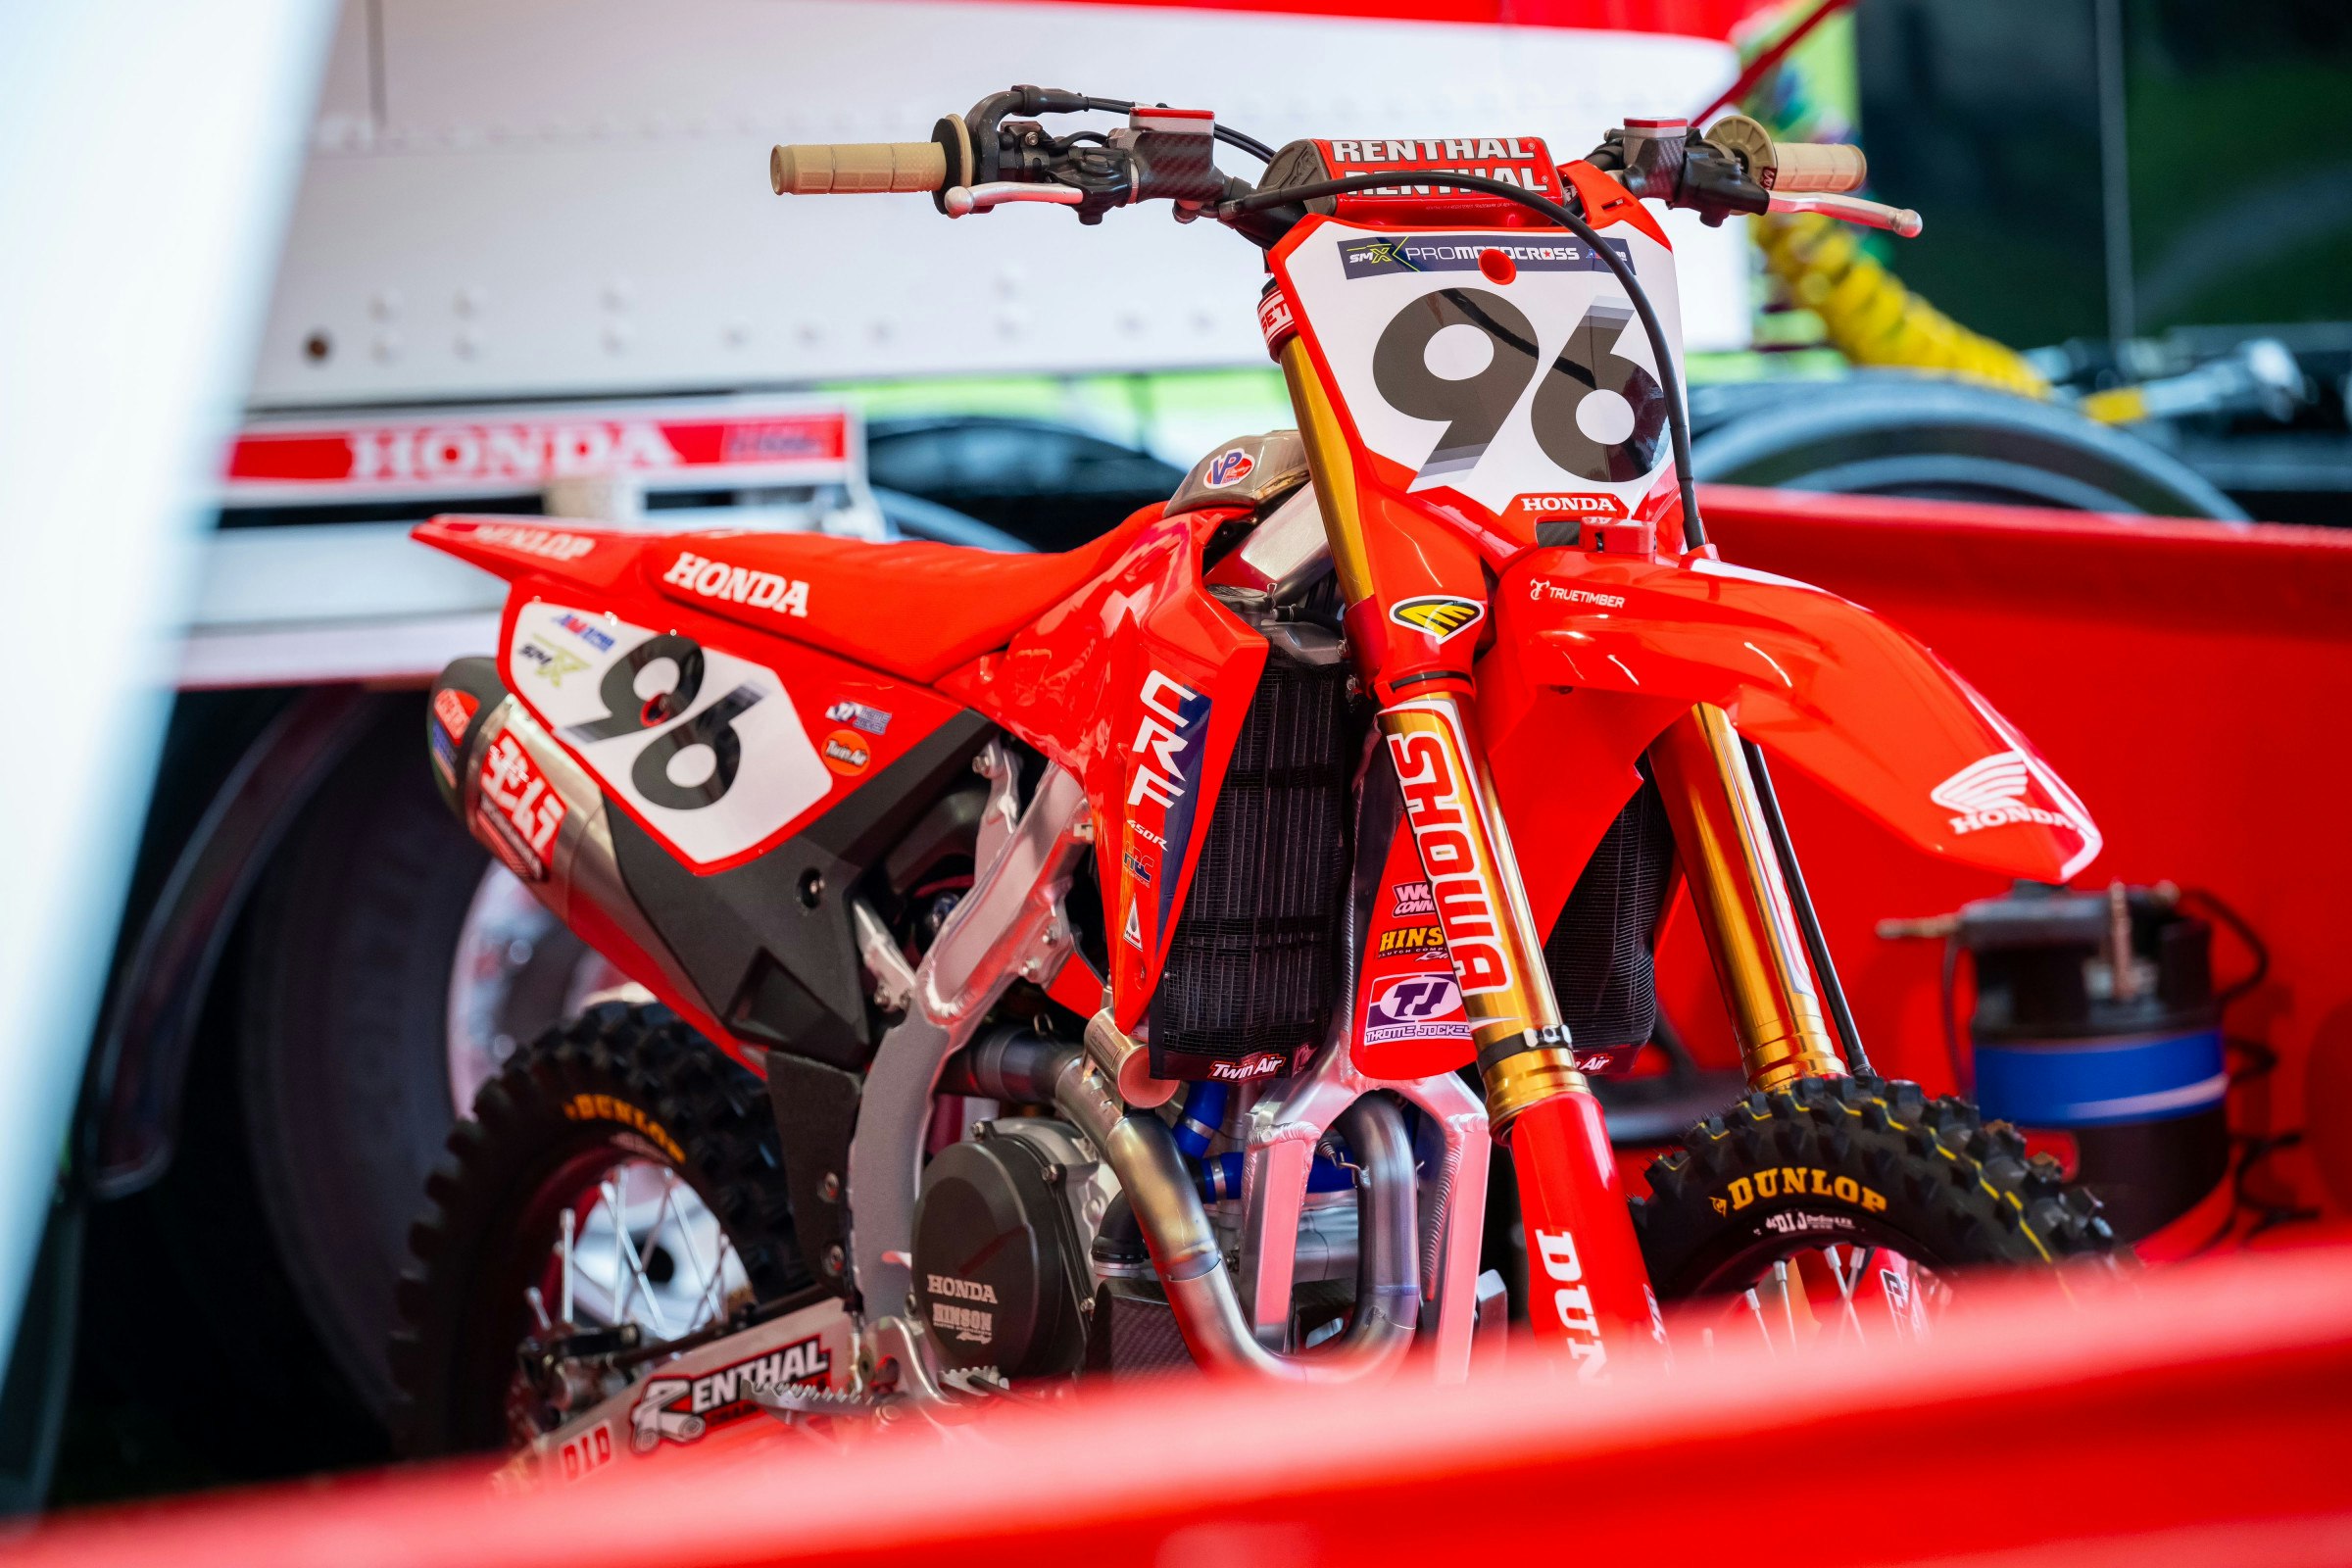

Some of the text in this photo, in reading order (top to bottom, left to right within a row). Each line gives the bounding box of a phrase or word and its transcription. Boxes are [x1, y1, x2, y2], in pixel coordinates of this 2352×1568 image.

[1332, 139, 1535, 163] RENTHAL
[1349, 247, 1393, 264] SMX
[1404, 246, 1580, 261] PROMOCROSS
[1372, 287, 1672, 493] 96
[349, 423, 684, 480] HONDA
[1212, 451, 1243, 484] VP
[1521, 497, 1617, 512] HONDA
[662, 552, 810, 618] HONDA
[1549, 586, 1626, 609] TRUETIMBER
[555, 633, 771, 810] 96
[1127, 669, 1197, 809] CRF
[1127, 819, 1168, 852] 450R
[1948, 807, 2077, 835] HONDA
[1387, 730, 1513, 997] SHOWA
[1394, 982, 1449, 1017] TJ
[1366, 1026, 1416, 1043] THROTTLE
[1212, 1056, 1283, 1079] Twin Air
[1579, 1055, 1610, 1071] Air
[1728, 1167, 1887, 1213] DUNLOP
[927, 1274, 999, 1304] HONDA
[932, 1302, 993, 1331] HINSON
